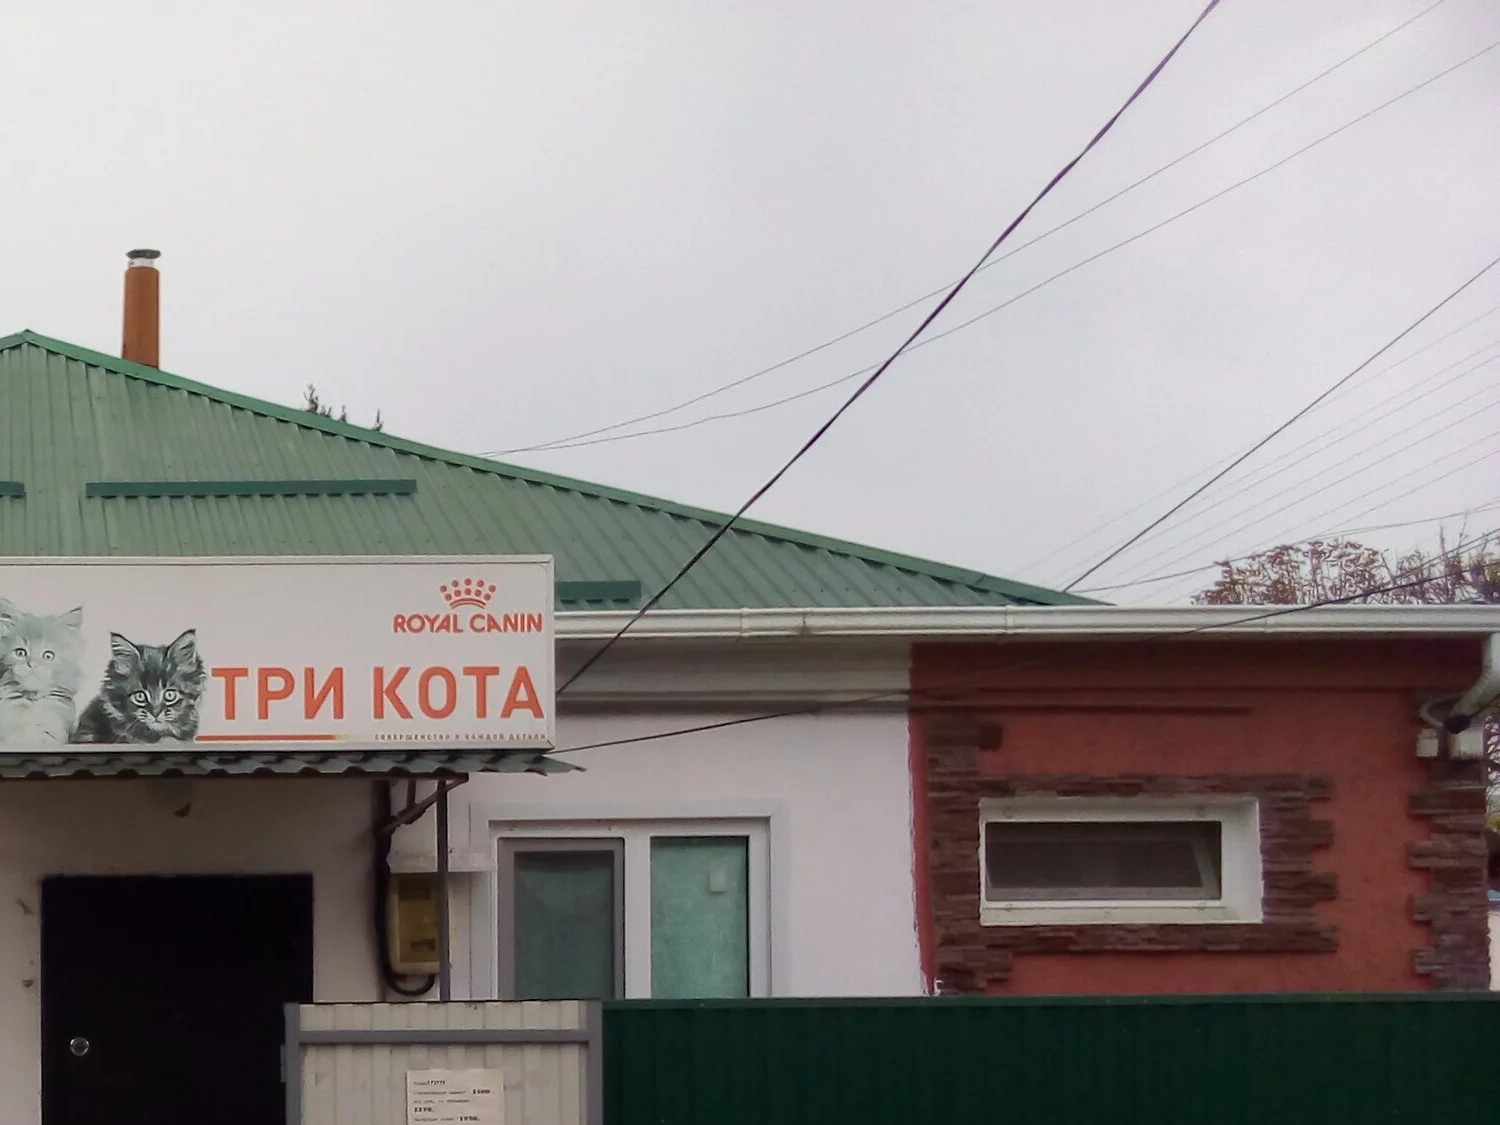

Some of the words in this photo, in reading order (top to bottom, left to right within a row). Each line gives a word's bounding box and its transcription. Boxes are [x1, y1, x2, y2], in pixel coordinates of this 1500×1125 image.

[393, 613, 463, 634] ROYAL
[469, 613, 543, 633] CANIN
[211, 667, 344, 721] ТРИ
[372, 665, 545, 720] КОТА
[508, 733, 547, 741] ДЕТАЛИ
